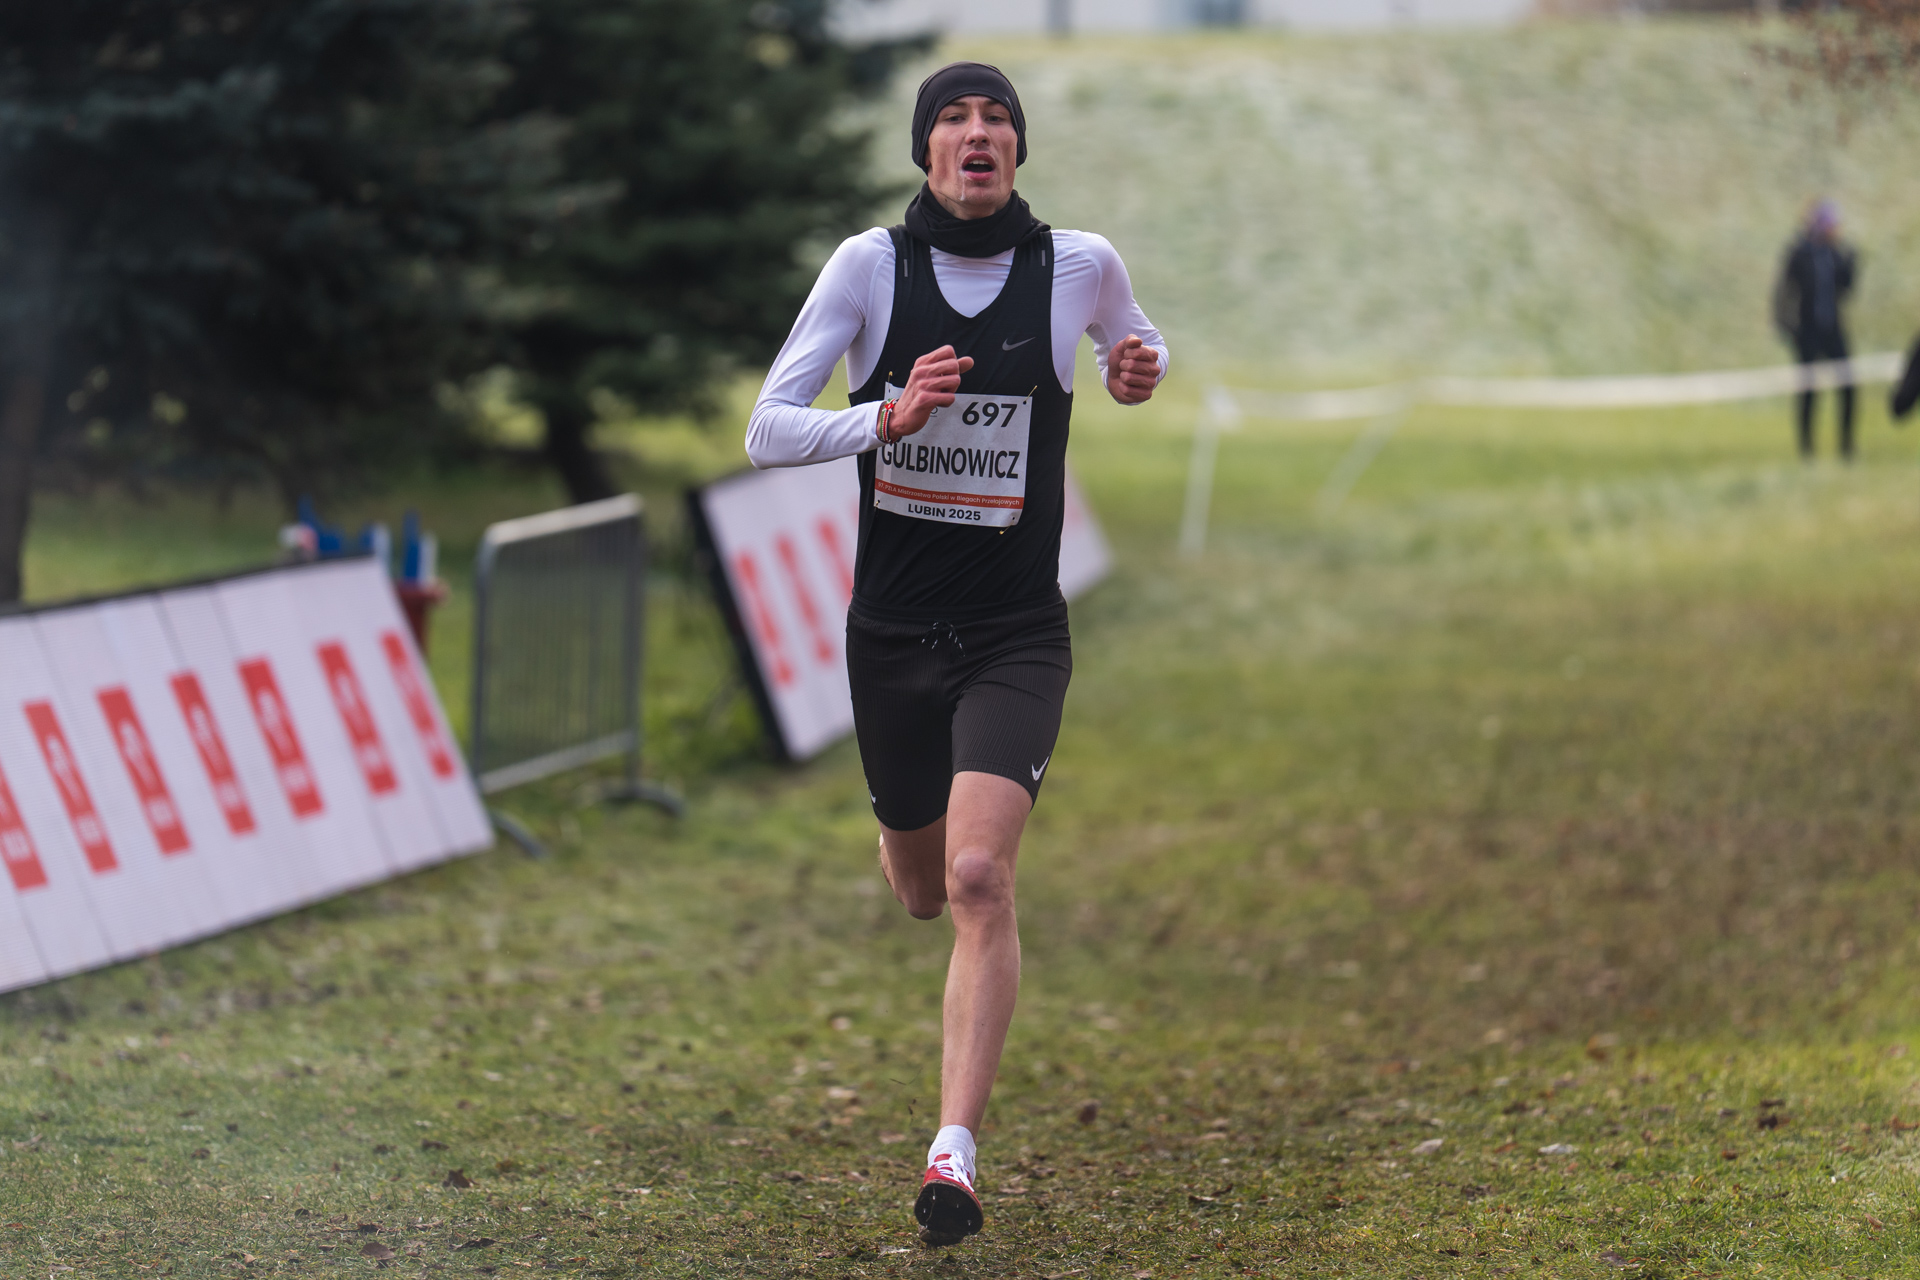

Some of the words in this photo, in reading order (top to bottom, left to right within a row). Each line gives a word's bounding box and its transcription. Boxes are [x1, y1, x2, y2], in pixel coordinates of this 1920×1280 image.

[962, 402, 1018, 427] 697
[881, 442, 1020, 479] GULBINOWICZ
[898, 488, 931, 498] Mistrzostwa
[956, 495, 980, 504] Biegach
[908, 504, 946, 518] LUBIN
[948, 508, 982, 521] 2025
